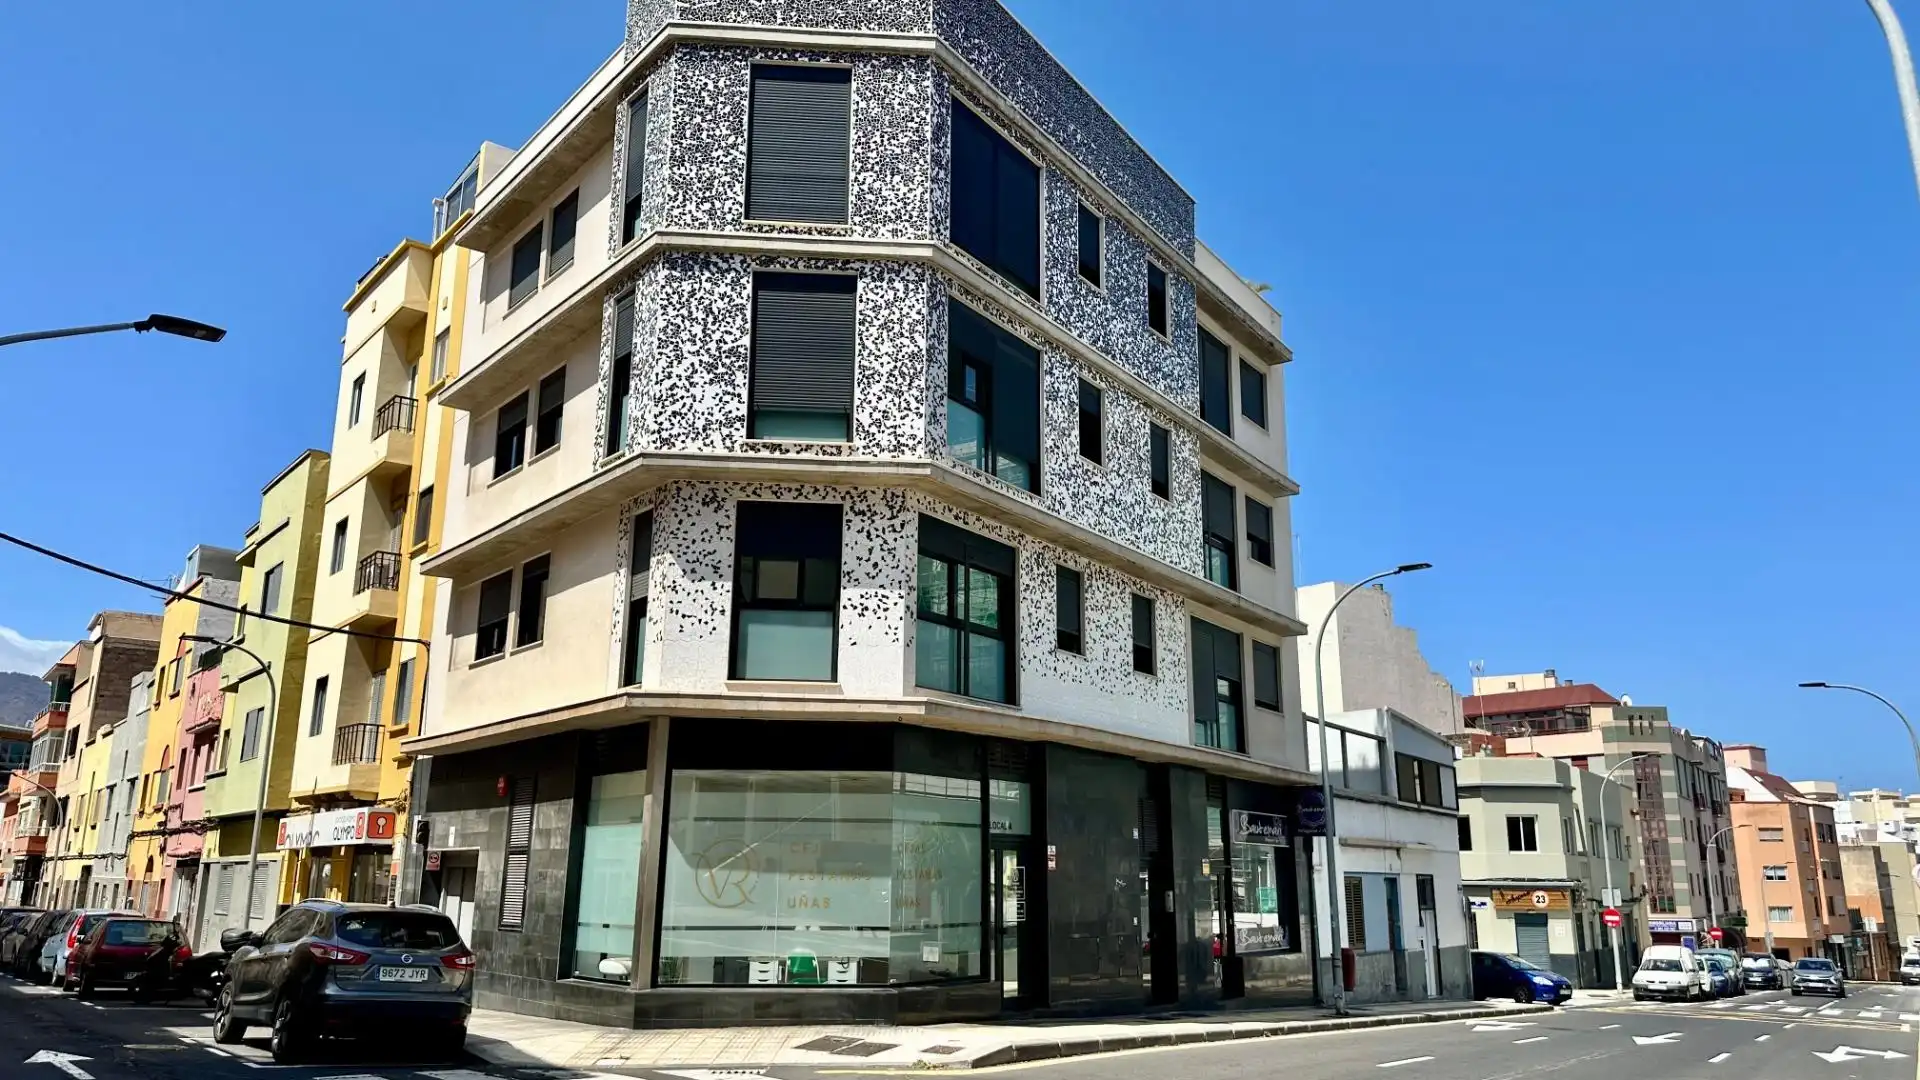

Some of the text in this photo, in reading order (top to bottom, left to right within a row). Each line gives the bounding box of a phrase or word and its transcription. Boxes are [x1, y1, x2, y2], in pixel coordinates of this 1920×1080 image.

[787, 894, 831, 909] UÑAS
[1535, 895, 1546, 904] 23
[382, 968, 426, 978] 9672 JYR
